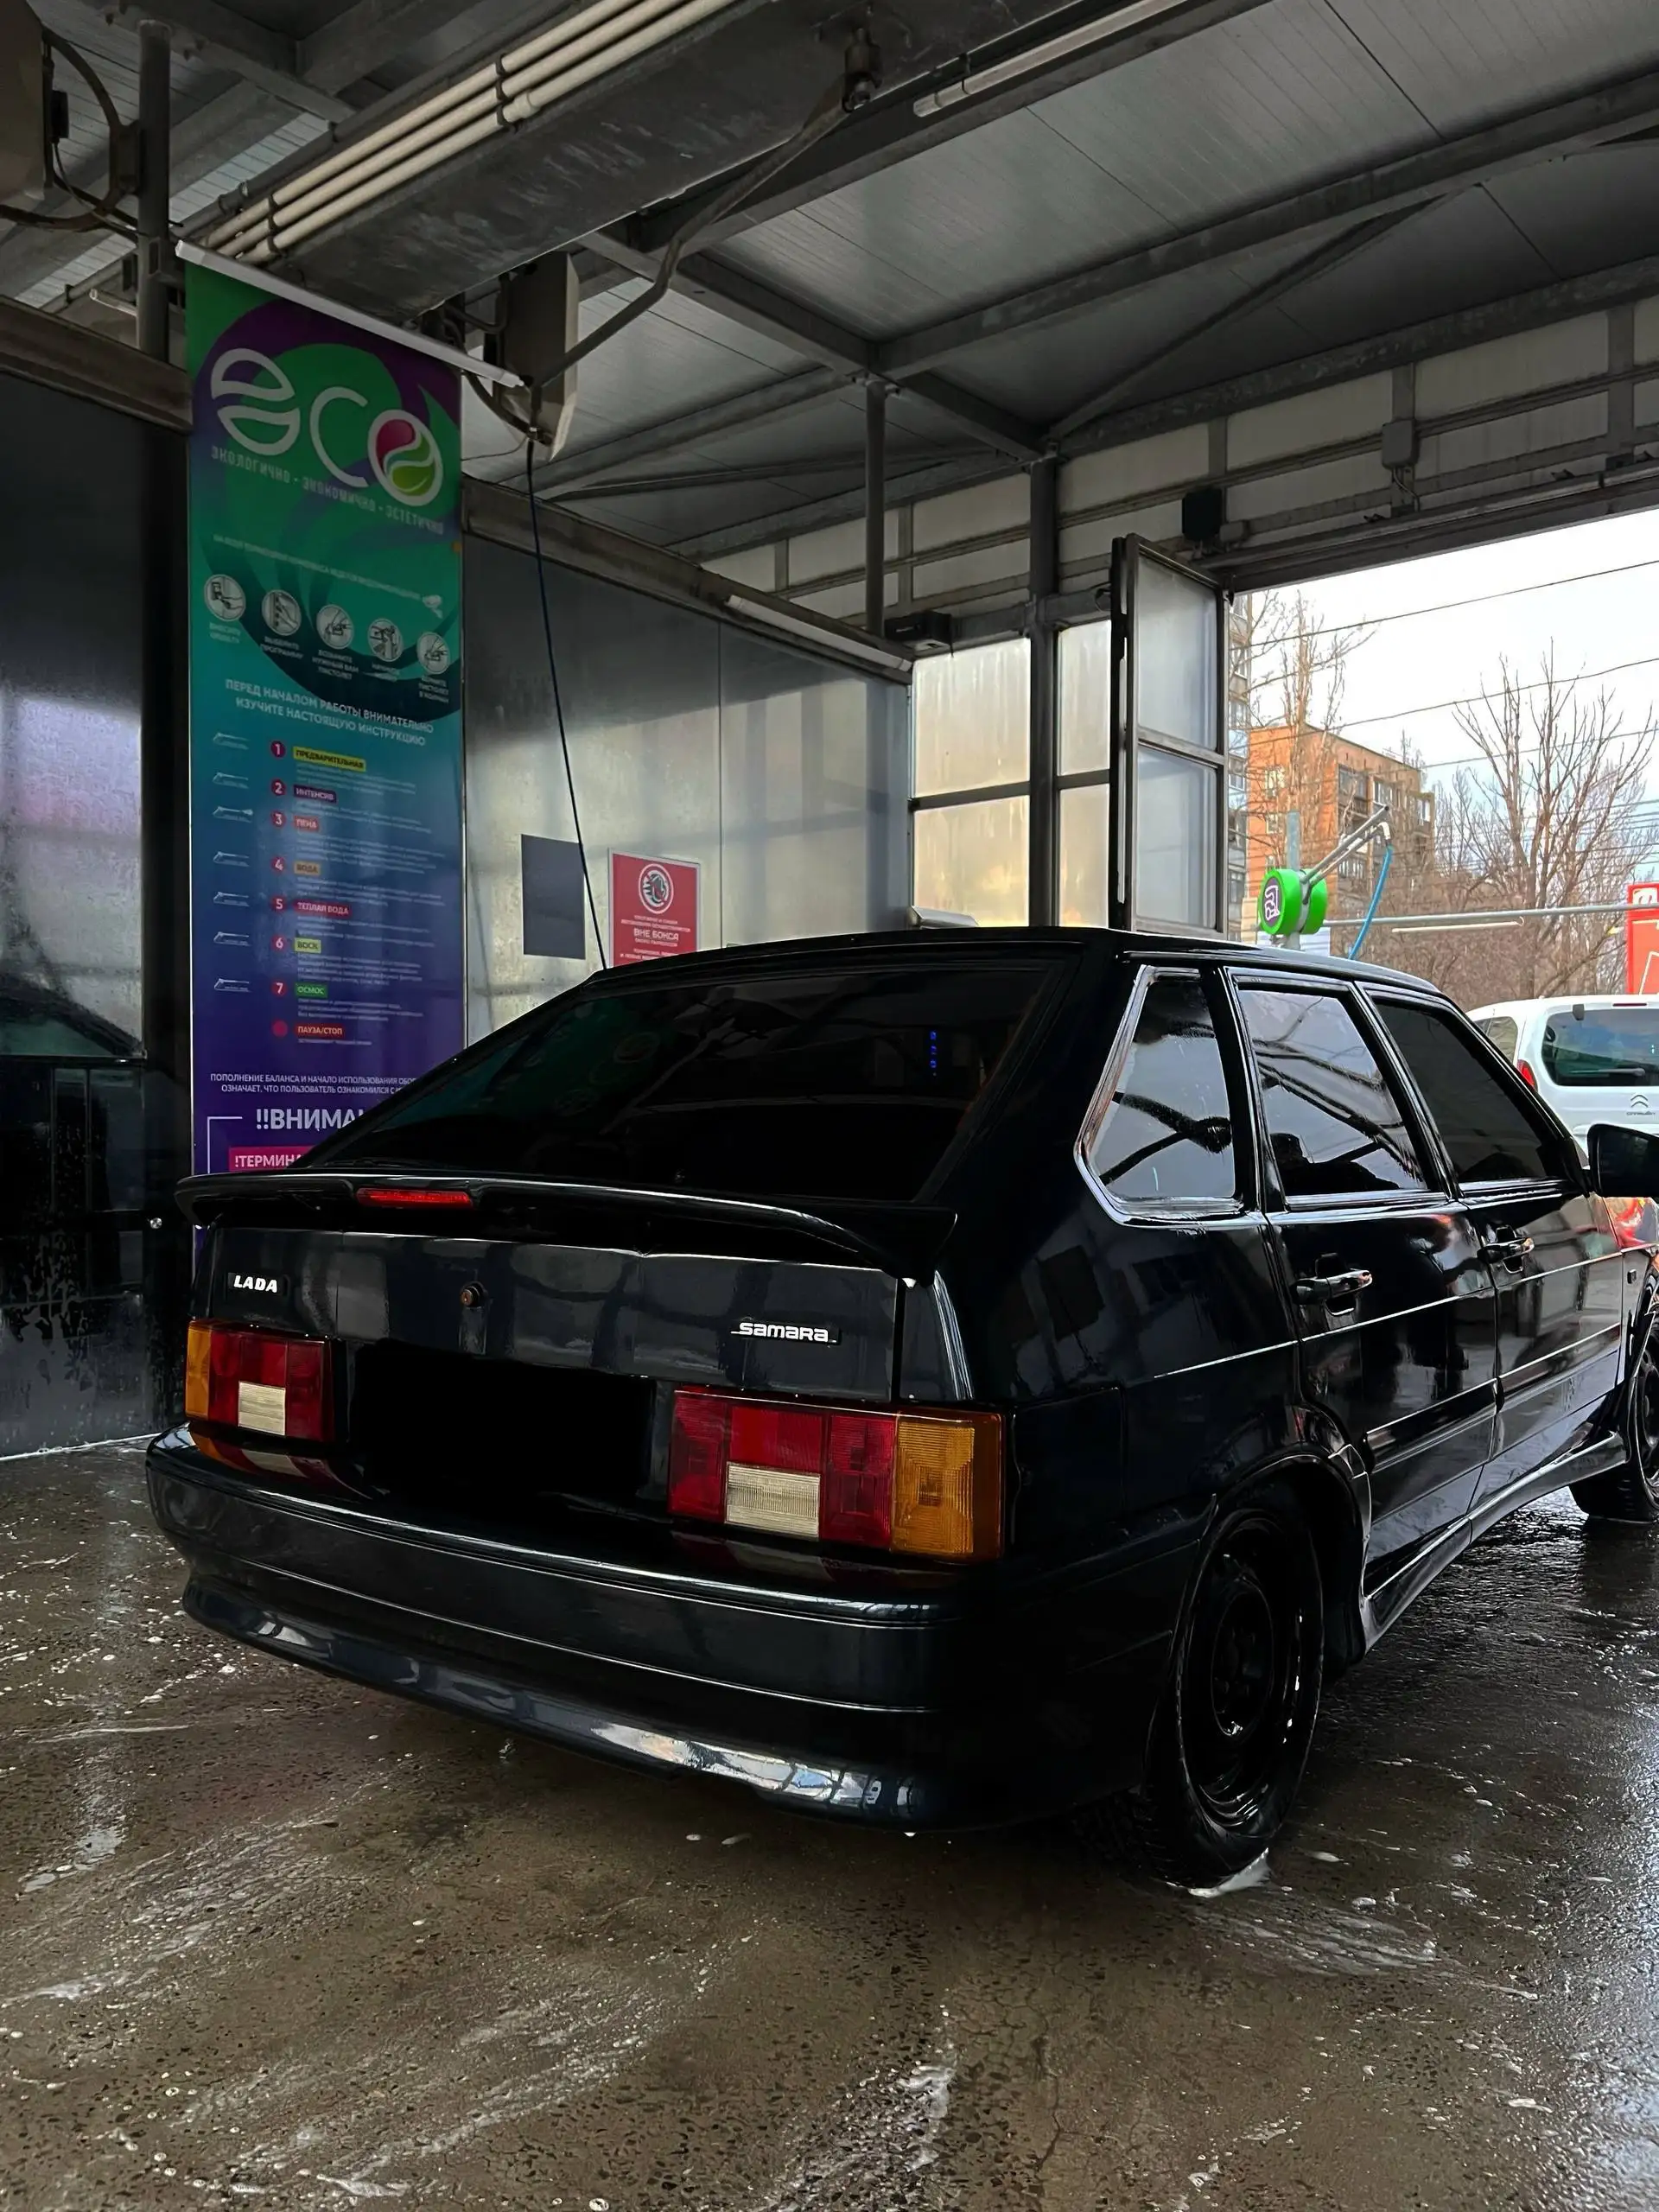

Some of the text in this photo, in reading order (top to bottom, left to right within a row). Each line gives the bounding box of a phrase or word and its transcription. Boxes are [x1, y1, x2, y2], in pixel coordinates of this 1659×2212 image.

[211, 445, 444, 536] ЭКОЛОГИЧНО ЭКОНОМИЧНО ЭСТЕТИЧНО
[225, 678, 434, 734] ПЕРЕД НАЧАЛОМ РАБОТЫ ВНИМАТЕЛЬНО
[235, 696, 426, 747] ИЗУЧИТЕ НАСТОЯЩУЮ ИНСТРУКЦИЮ
[274, 743, 281, 755] 1
[274, 782, 283, 794] 2
[275, 813, 283, 825] 3
[275, 859, 283, 871] 4
[276, 899, 283, 910] 5
[327, 905, 349, 915] ВОДА
[633, 928, 679, 941] ВНЕ БОКСА
[276, 937, 283, 949] 6
[276, 982, 283, 994] 7
[297, 1026, 343, 1036] ПАУЗА/СТОП
[210, 1073, 264, 1083] ПОПОЛНЕНИЕ
[264, 1074, 300, 1084] БАЛАНСА
[308, 1076, 337, 1084] НАЧАЛО
[338, 1077, 397, 1085] ИСПОЛЬЗОВАНИЯ
[264, 1084, 279, 1093] ЧТО
[280, 1084, 336, 1094] ПОЛЬЗОВАТЕЛЬ
[337, 1086, 390, 1095] ОЗНАКОМИЛСЯ
[256, 1109, 364, 1129] !!ВНИМА
[234, 1154, 302, 1168] !ТЕРМИН
[233, 1274, 278, 1294] LADA
